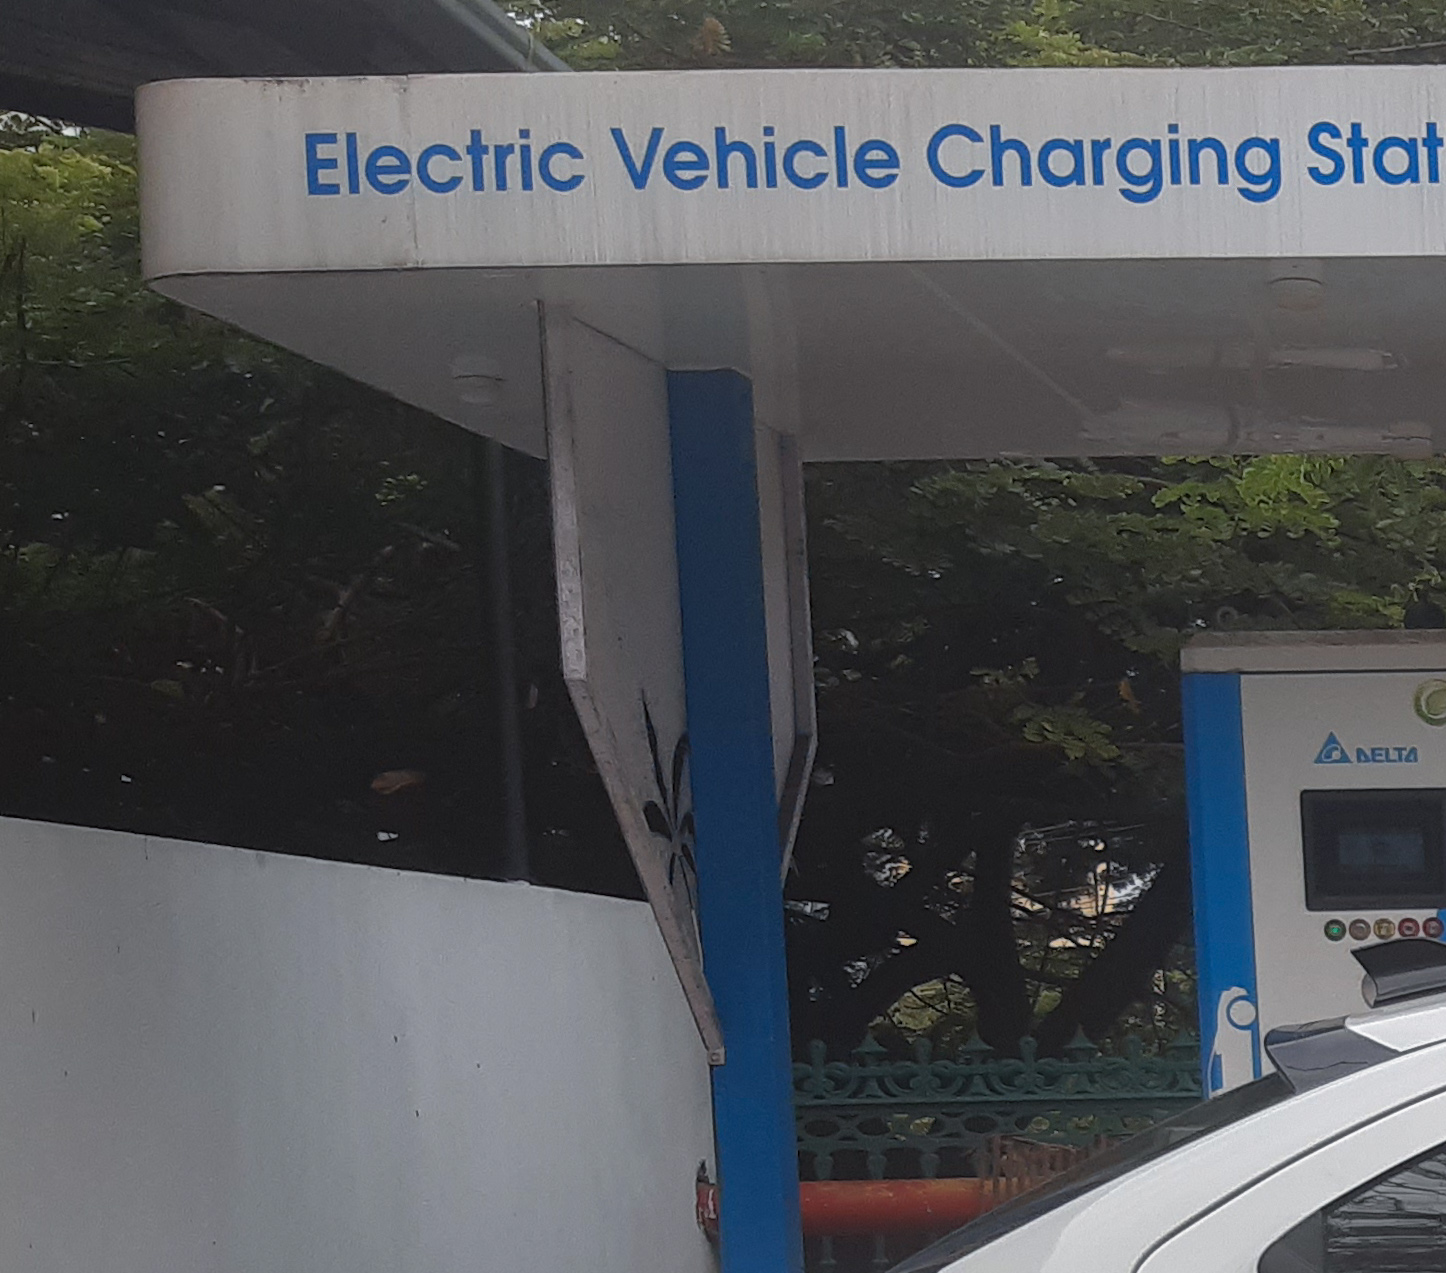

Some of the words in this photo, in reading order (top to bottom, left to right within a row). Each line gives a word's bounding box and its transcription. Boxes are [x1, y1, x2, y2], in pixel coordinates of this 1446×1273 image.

[304, 127, 587, 197] Electric
[609, 125, 902, 191] Vehicle
[926, 122, 1282, 204] Charging
[1356, 746, 1419, 763] DELTA
